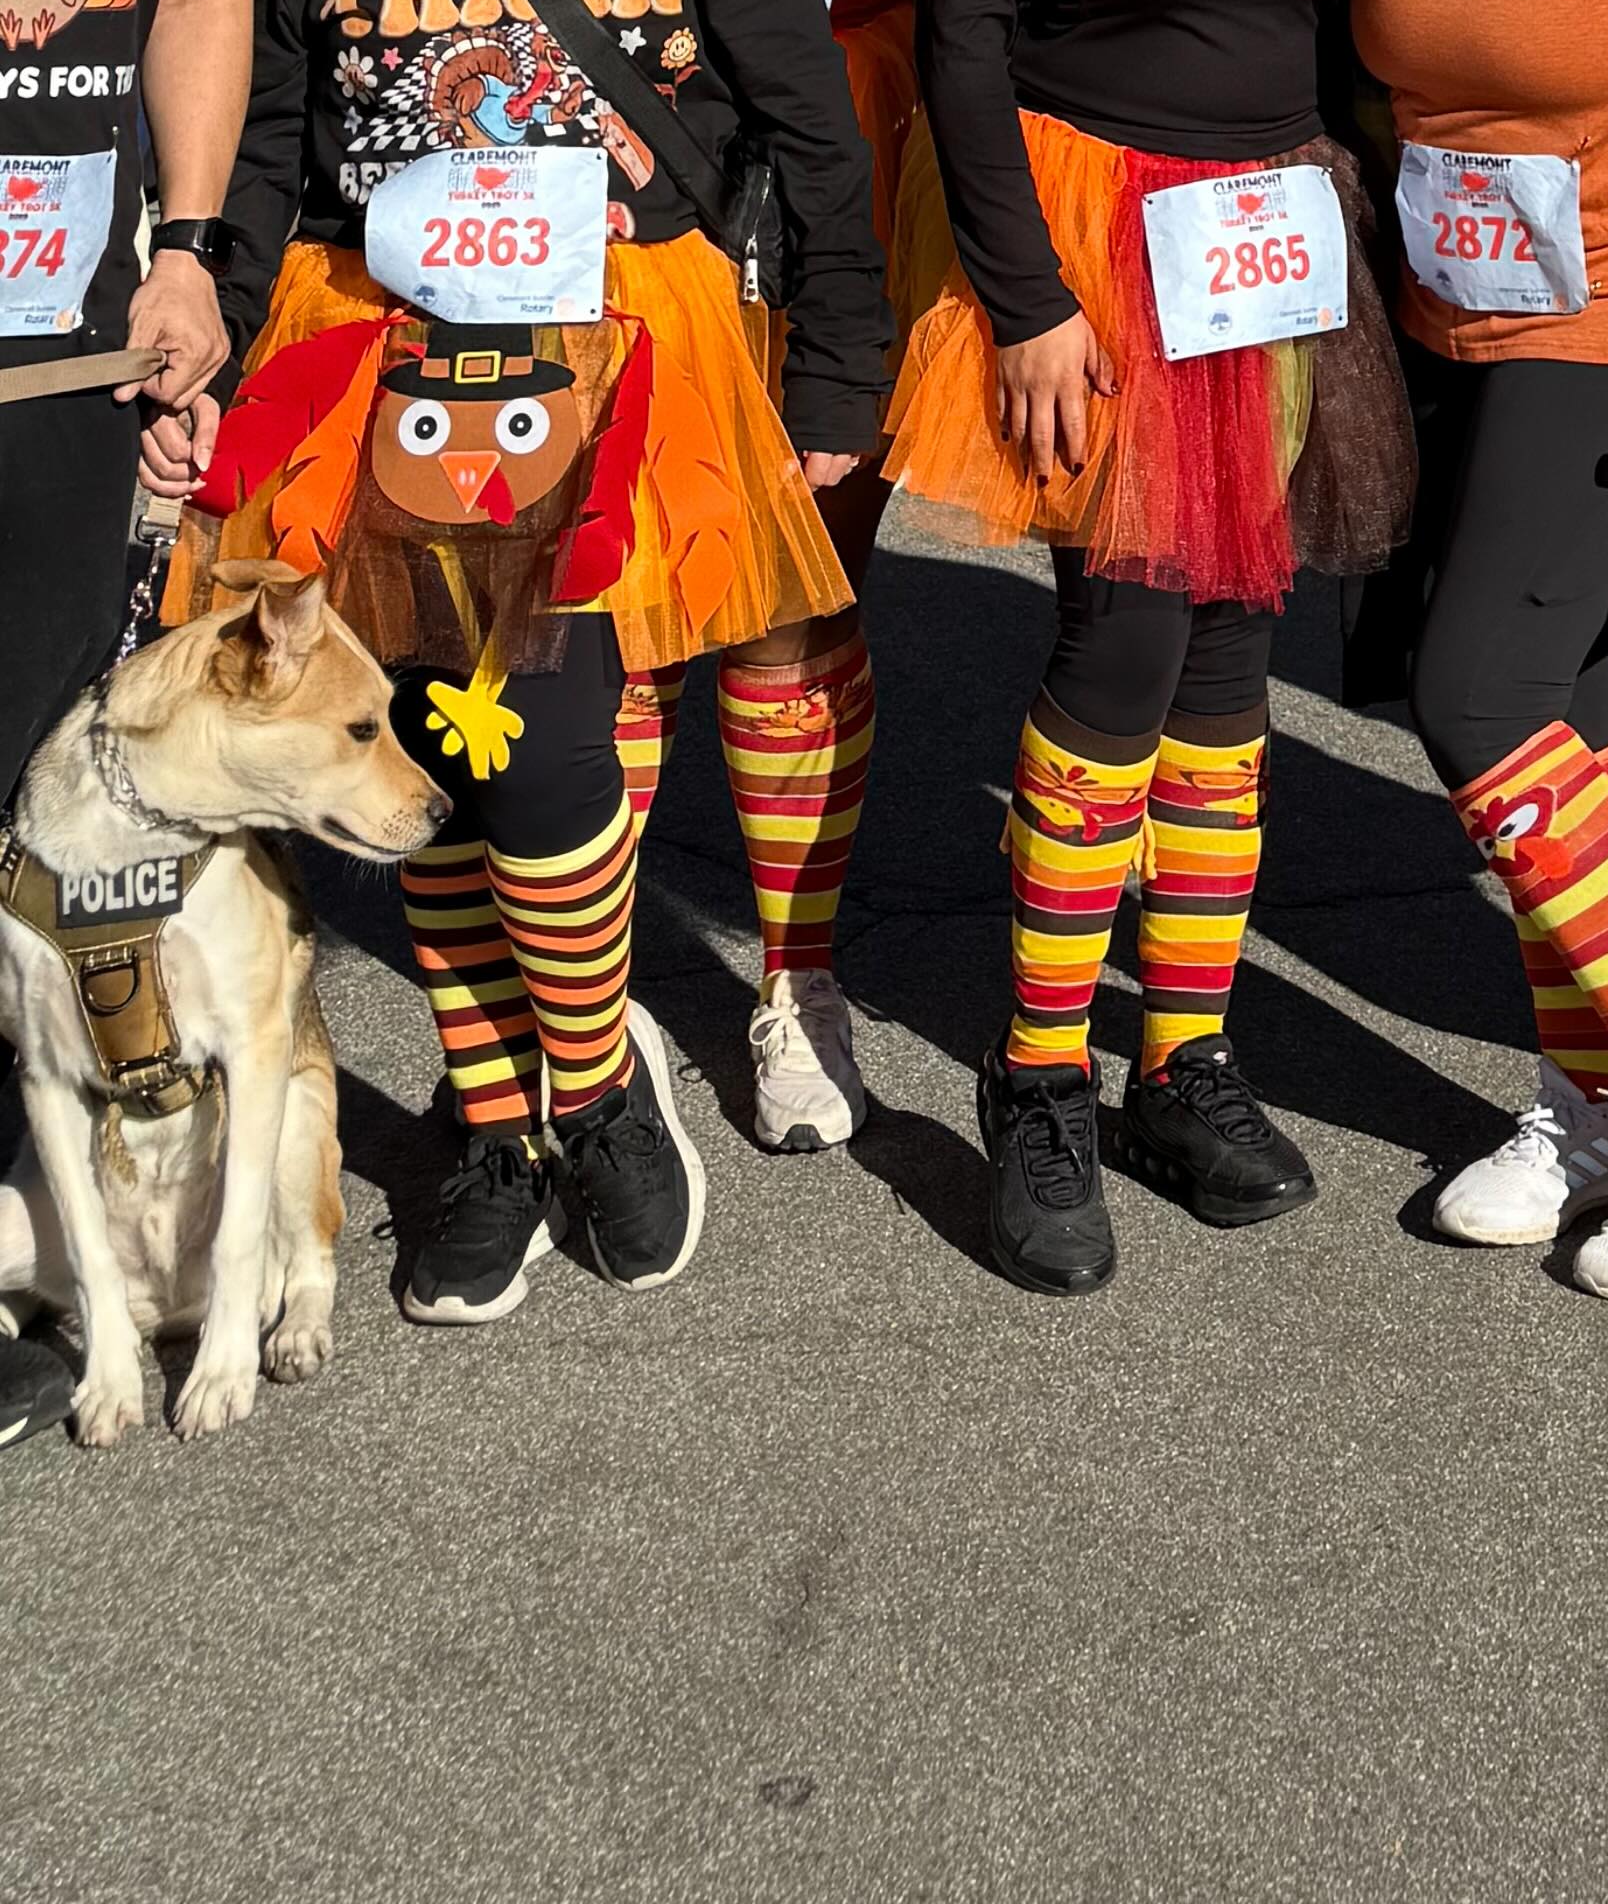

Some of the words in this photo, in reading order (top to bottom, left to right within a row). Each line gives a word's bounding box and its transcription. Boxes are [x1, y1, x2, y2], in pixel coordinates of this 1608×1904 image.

[49, 65, 109, 97] FOR
[451, 150, 538, 165] CLAREMONT
[421, 217, 551, 267] 2863
[1432, 211, 1538, 262] 2872
[1205, 234, 1310, 295] 2865
[62, 859, 178, 915] POLICE
